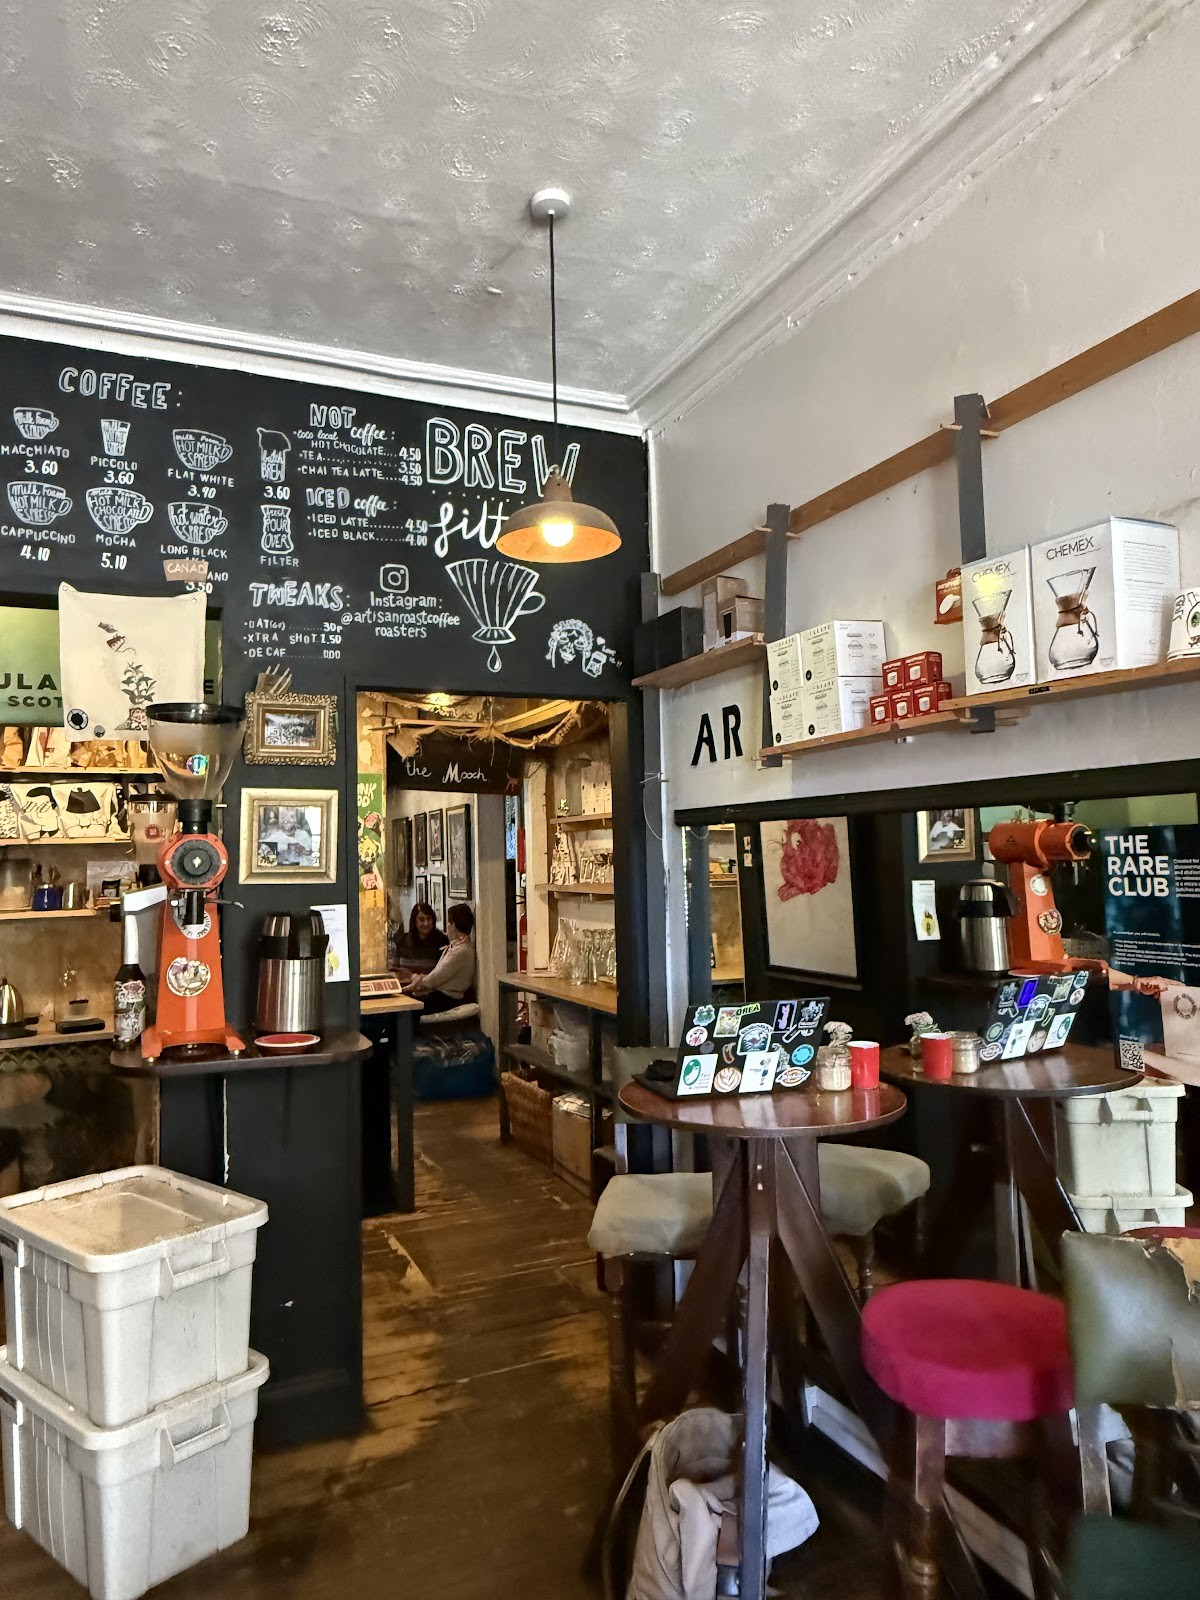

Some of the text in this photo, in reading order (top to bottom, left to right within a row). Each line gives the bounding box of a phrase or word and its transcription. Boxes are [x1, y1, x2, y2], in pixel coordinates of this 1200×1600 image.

[310, 403, 356, 429] NOT
[1, 444, 70, 458] MACCHIATO
[311, 440, 421, 461] HOT CHOCOLATE 4.50
[426, 417, 580, 497] BREW
[24, 460, 58, 476] 3.60
[90, 456, 138, 471] PICCOLO
[302, 450, 422, 475] TEA 3.50
[104, 470, 134, 485] 3.60
[168, 468, 235, 487] FLAT WHITE
[301, 465, 423, 486] CHAI TEA LATTE 4.50
[187, 485, 216, 499] 3.90
[263, 486, 290, 500] 3.60
[306, 487, 350, 509] ICED
[31, 497, 55, 511] MILK
[89, 496, 140, 508] HOT MILK
[312, 514, 428, 533] ICED LATTE 4.50
[429, 501, 509, 558] filt
[1, 526, 76, 544] CAPPUCCINO
[96, 534, 136, 547] MOCHA
[313, 528, 428, 546] ICED BLACK 4.00
[20, 545, 51, 561] 4.10
[161, 545, 227, 558] LONG BLACK
[1046, 536, 1094, 560] CHEMEX
[101, 553, 127, 570] 5.10
[261, 556, 299, 567] FILTER
[370, 591, 442, 610] Instagram:
[341, 608, 460, 628] @artisanroastcoffee
[248, 632, 342, 645] XTRA SHOT 1.50
[375, 624, 427, 639] roasters
[249, 647, 286, 658] DECAF
[8, 696, 62, 708] SCOT
[405, 759, 487, 784] the Mooch
[1104, 835, 1149, 855] THE
[1107, 856, 1170, 875] RARE
[1108, 877, 1169, 896] CLUB
